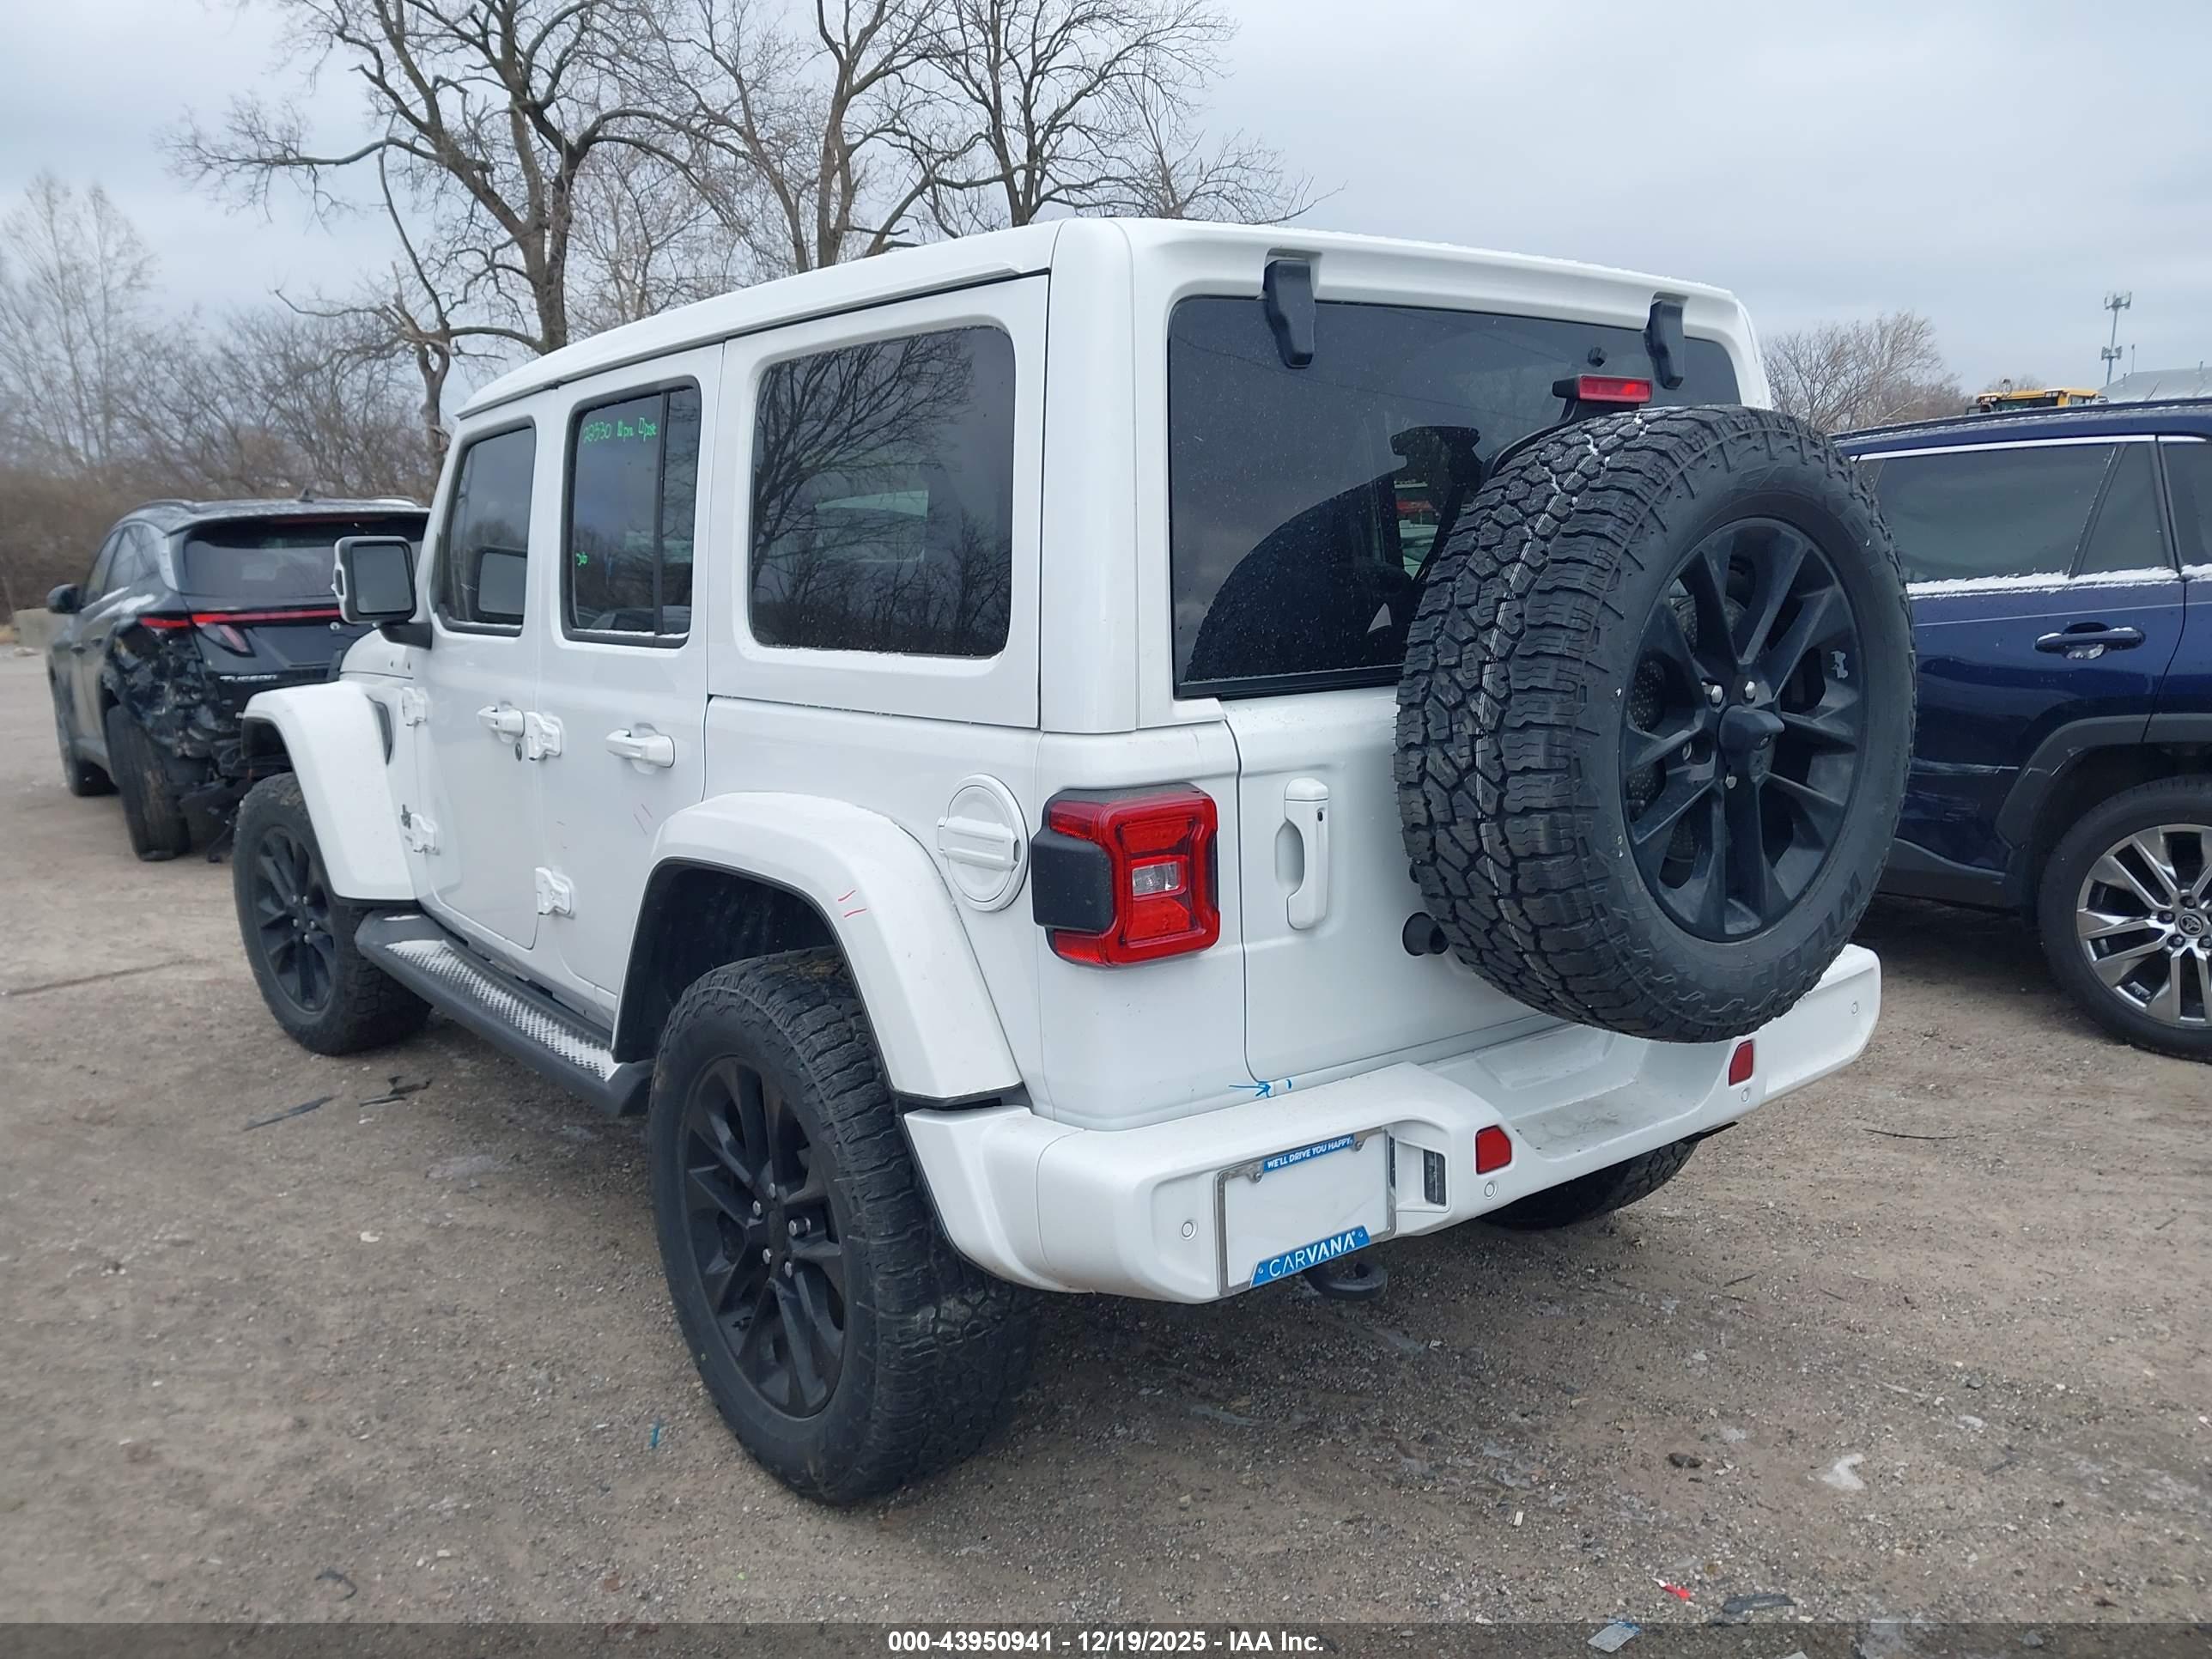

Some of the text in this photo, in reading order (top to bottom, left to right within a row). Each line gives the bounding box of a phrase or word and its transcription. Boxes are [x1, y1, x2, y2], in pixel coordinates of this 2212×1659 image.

[1267, 1155, 1288, 1169] WE'LL
[1289, 1149, 1311, 1162] DRIVE
[1312, 1143, 1328, 1155] YOU
